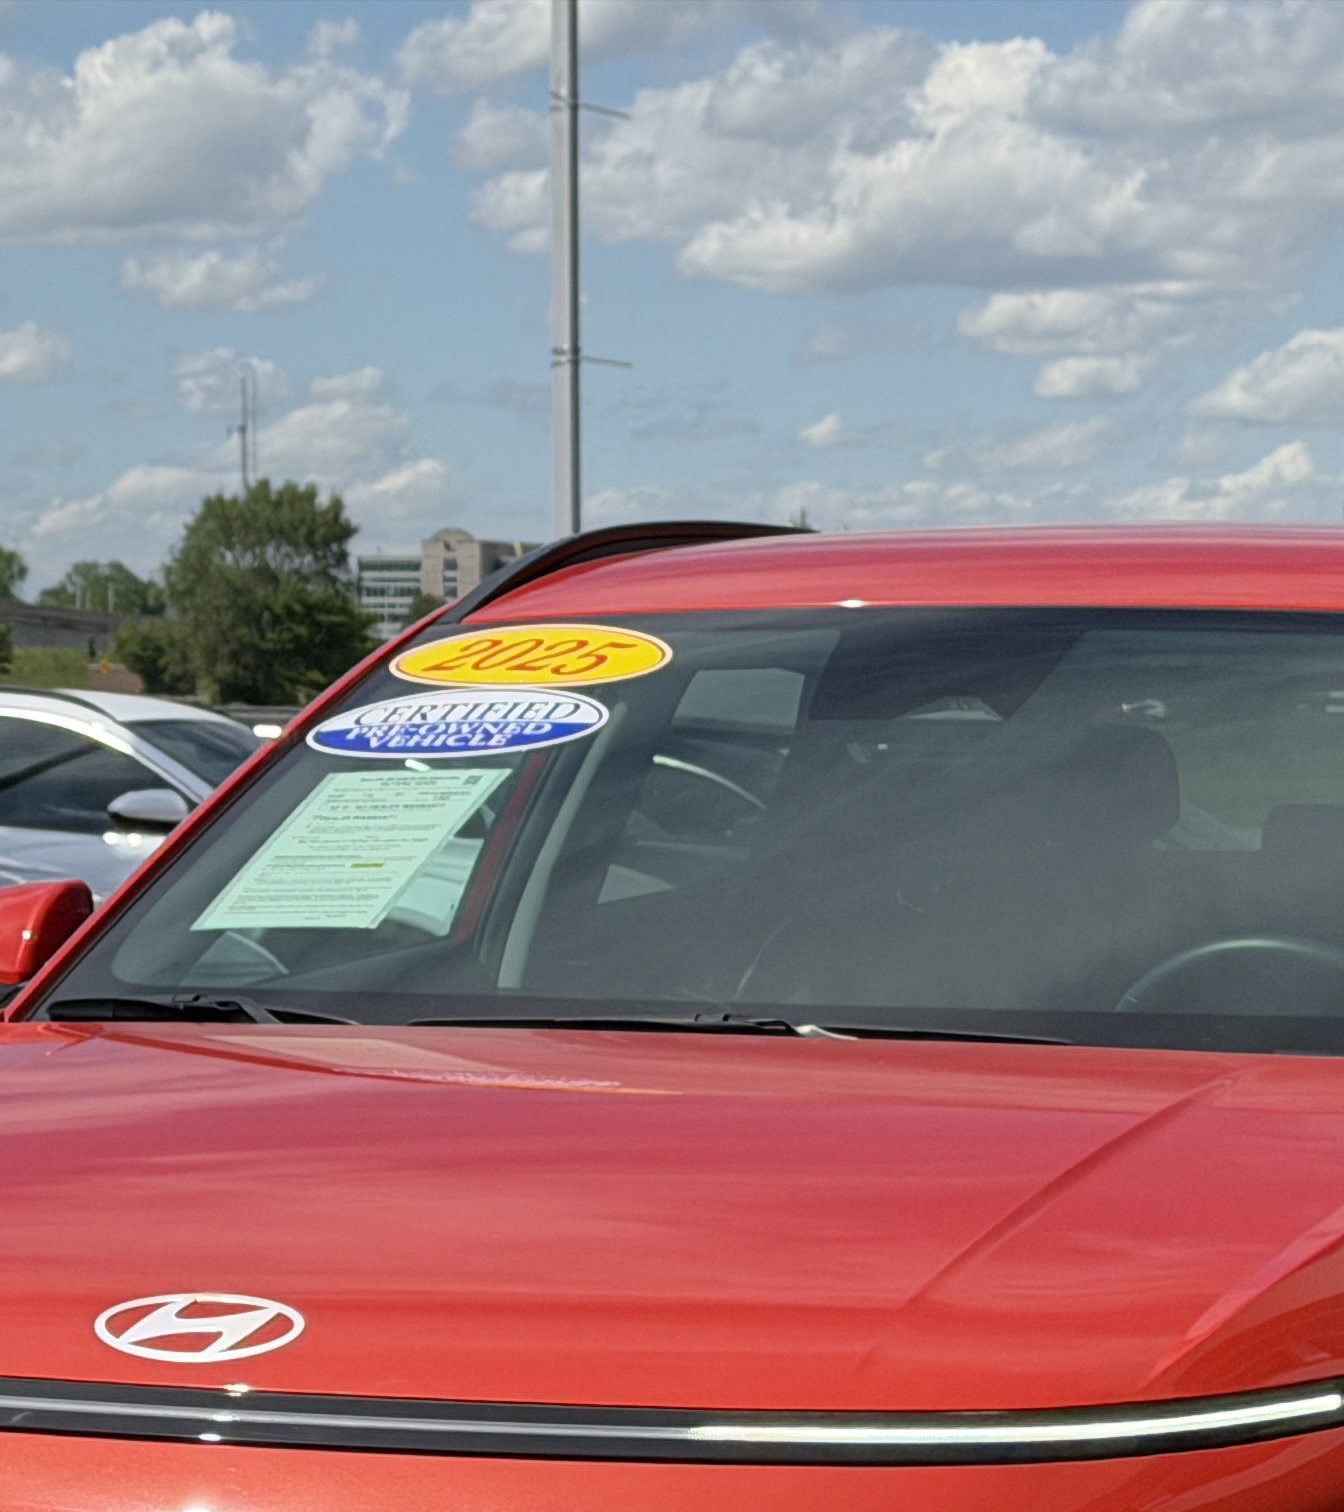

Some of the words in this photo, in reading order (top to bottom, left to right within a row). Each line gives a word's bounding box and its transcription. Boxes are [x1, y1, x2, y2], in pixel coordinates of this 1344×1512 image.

[421, 638, 638, 676] 2025
[353, 701, 582, 726] CERTIFIED
[345, 721, 553, 740] PRE-OWNED
[368, 733, 512, 749] VEHICLE
